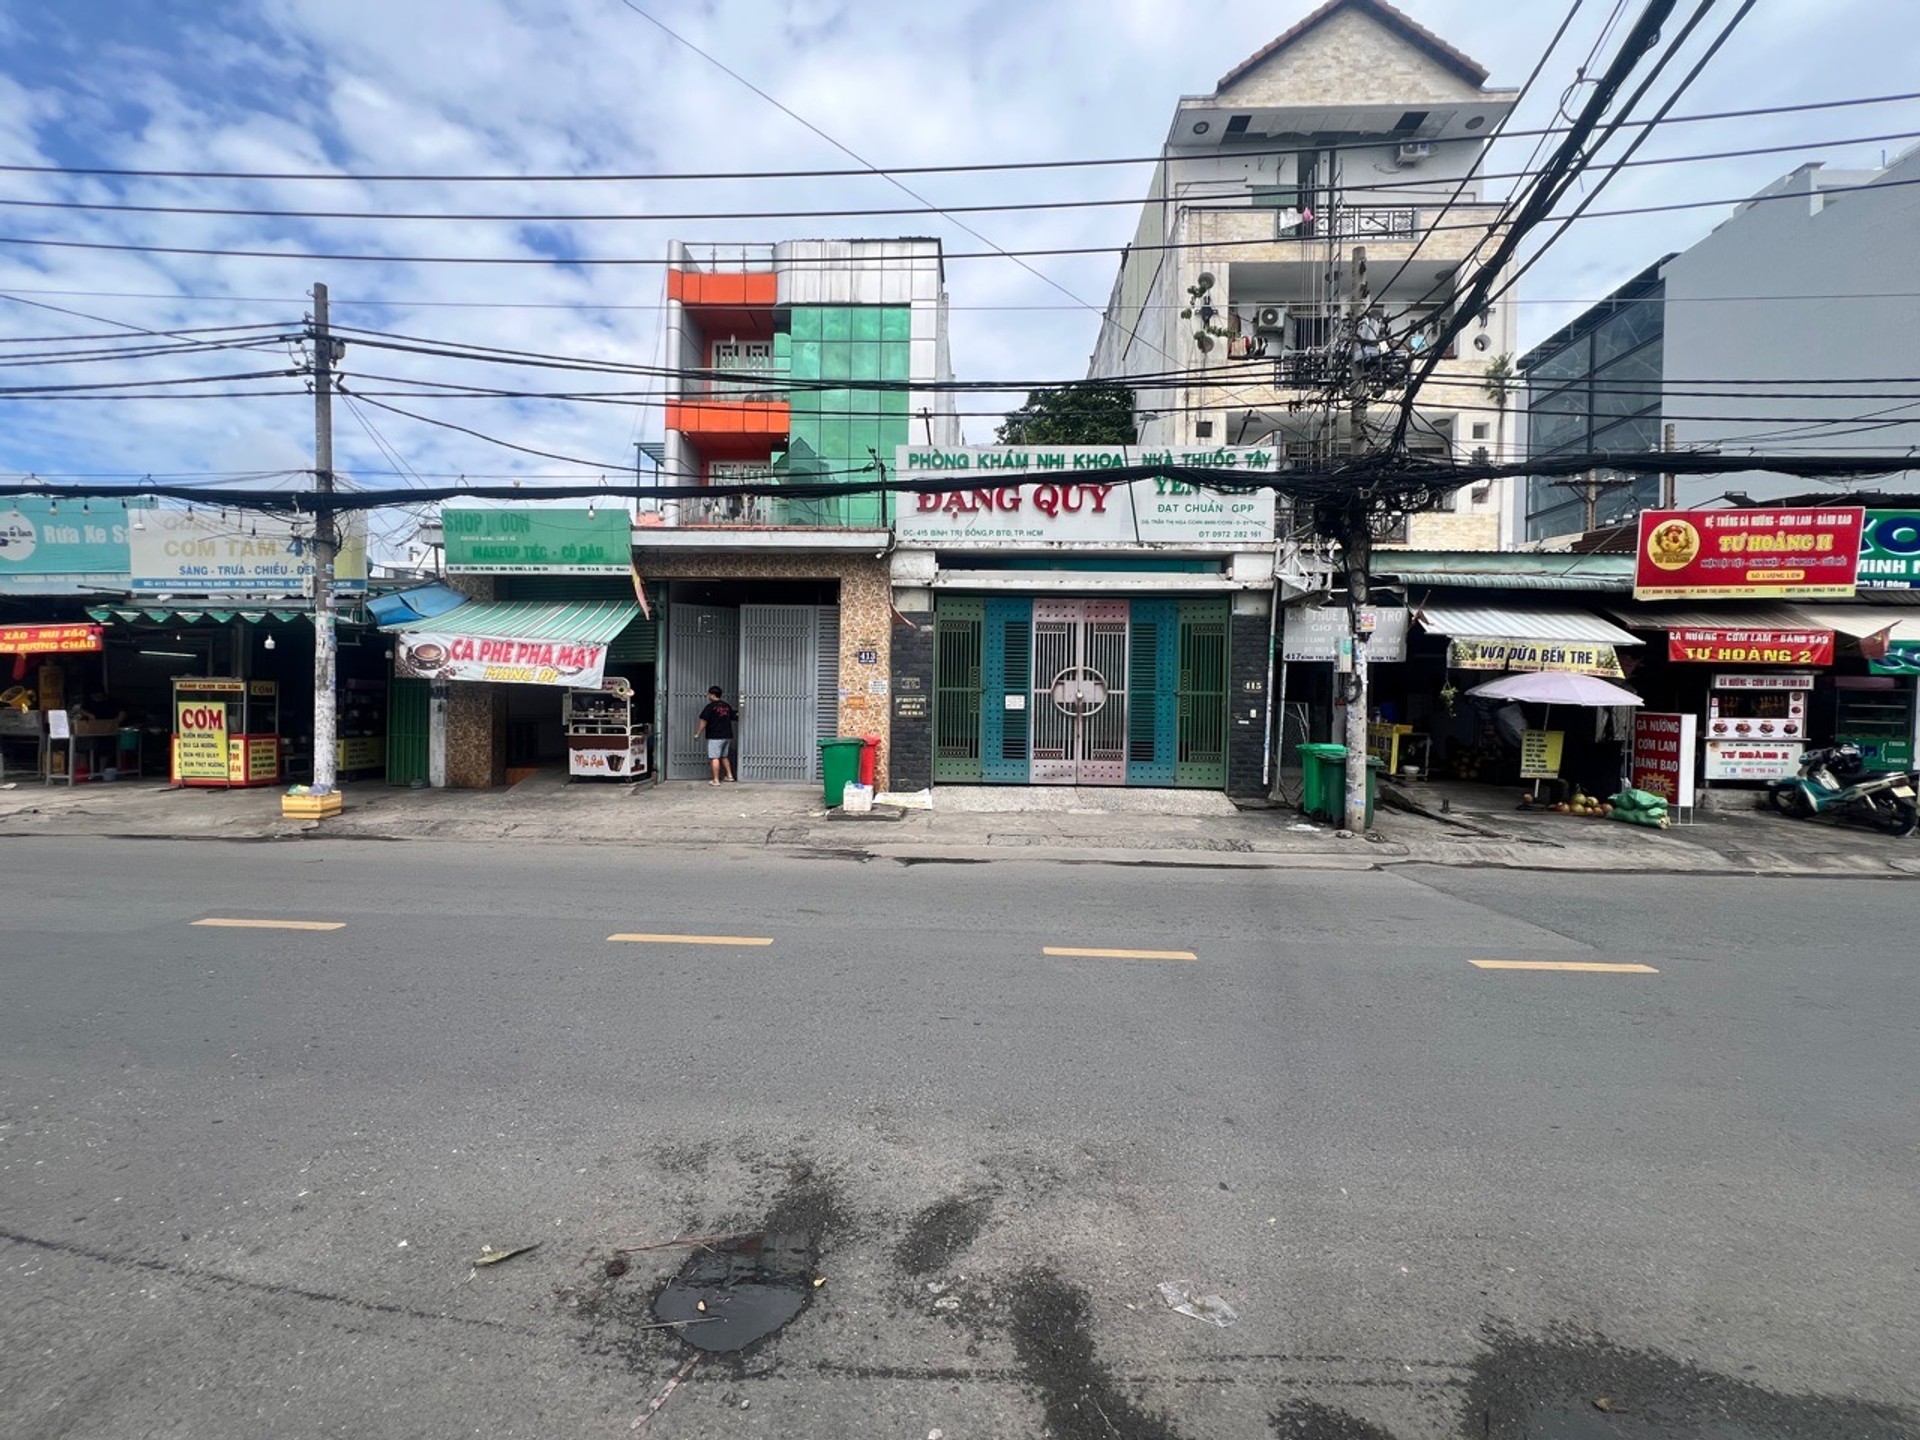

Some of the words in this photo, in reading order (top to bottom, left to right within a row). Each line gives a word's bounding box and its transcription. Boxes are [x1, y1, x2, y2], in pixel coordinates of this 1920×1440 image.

[909, 449, 969, 469] PHÒNG
[978, 449, 1028, 469] KHÁM
[1037, 453, 1065, 469] NHI
[1073, 453, 1123, 469] KHOA
[1142, 449, 1174, 465] NHÀ
[1181, 447, 1236, 467] THUỐC
[1245, 450, 1271, 468] TÂY
[1231, 504, 1254, 513] GPP
[445, 513, 482, 532] SHOP
[1797, 515, 1812, 525] LAM
[1746, 531, 1814, 552] HOÀNG
[472, 546, 519, 558] MAKEUP
[1726, 631, 1748, 642] CƠM
[1750, 632, 1771, 643] LAM
[517, 639, 553, 666] PHA
[860, 652, 876, 660] 413
[1571, 651, 1593, 664] TRE
[1685, 647, 1712, 659] TƯ
[1718, 647, 1792, 661] HOÀNG
[1799, 650, 1812, 662] 2
[483, 666, 536, 681] MANG
[182, 705, 223, 730] CƠM
[1637, 719, 1647, 731] GÀ
[1658, 740, 1677, 752] LAM
[1660, 759, 1678, 772] BAO
